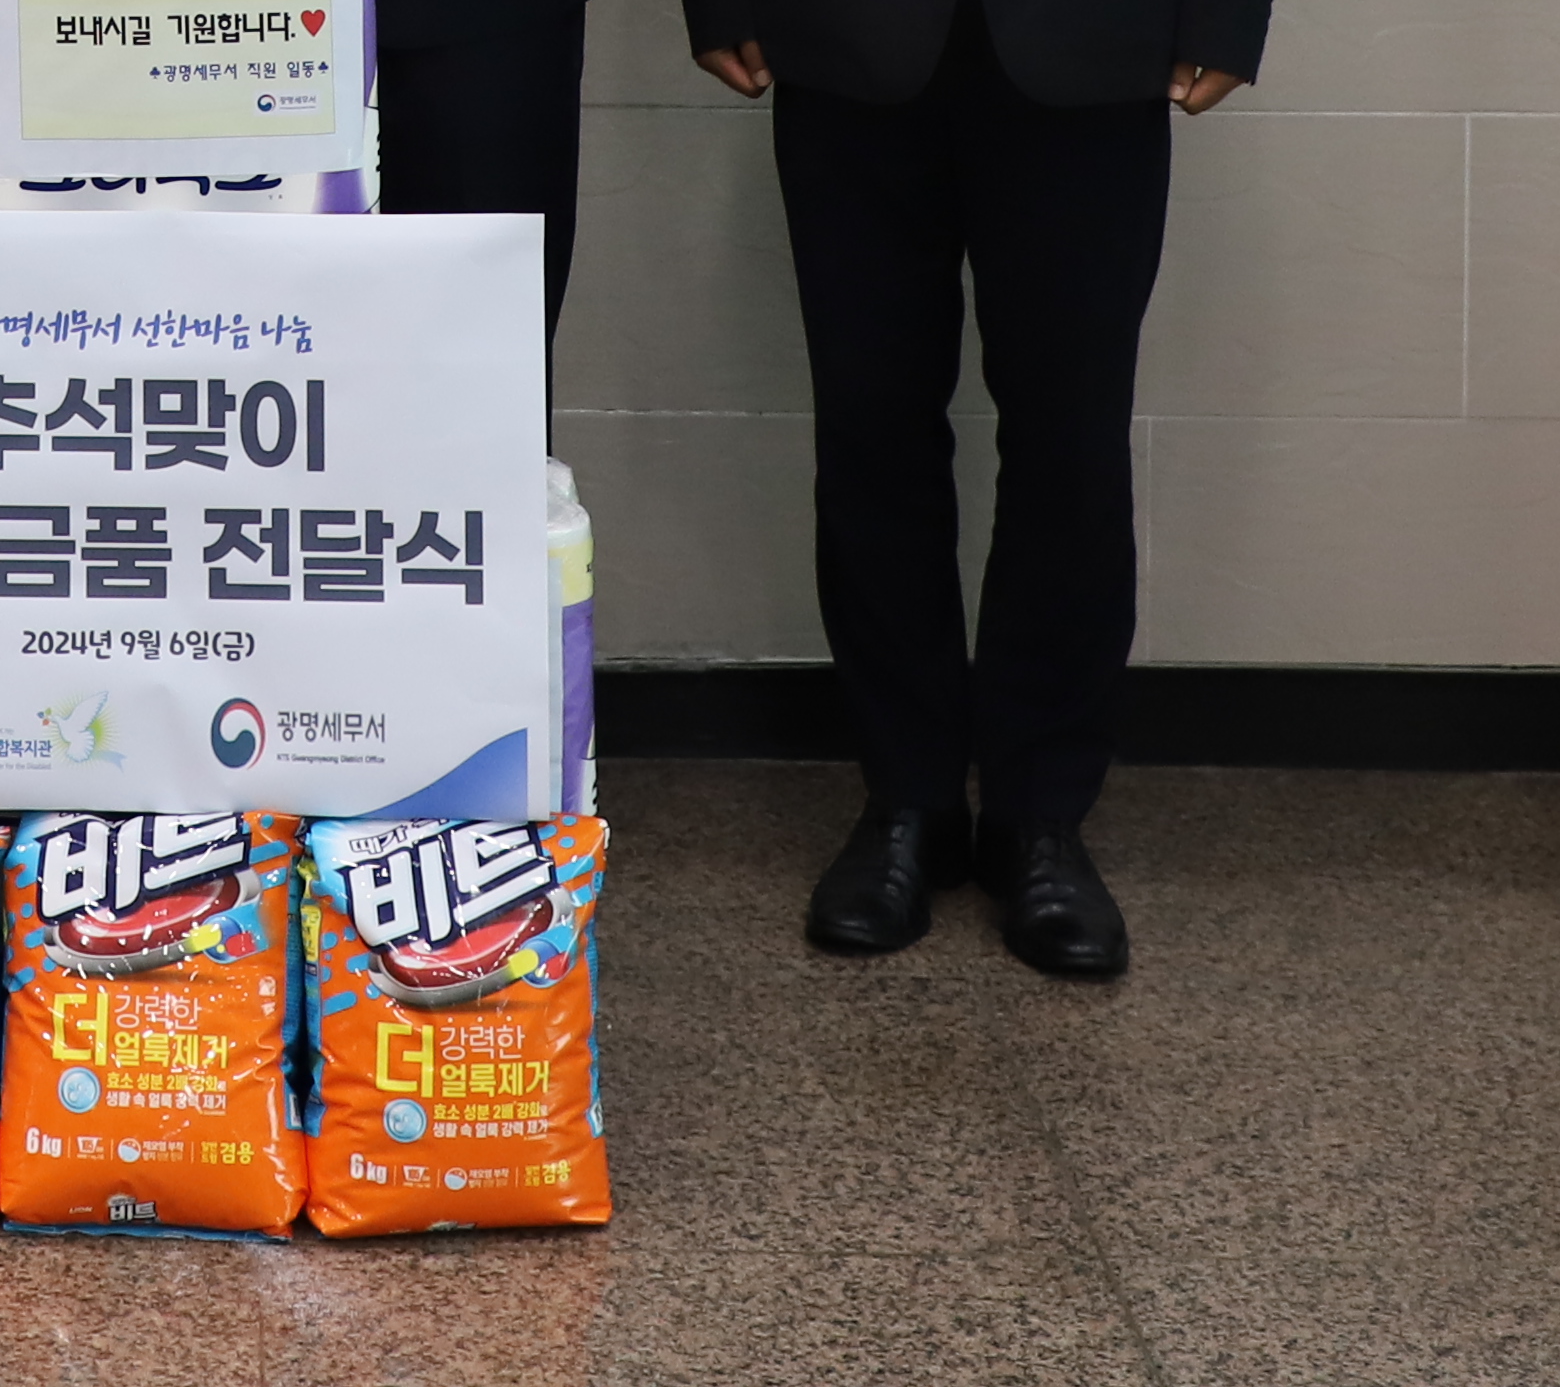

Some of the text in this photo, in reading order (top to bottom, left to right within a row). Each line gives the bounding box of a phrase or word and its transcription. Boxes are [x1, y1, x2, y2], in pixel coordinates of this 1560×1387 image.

[57, 12, 295, 45] 보내시길 기원합니다.
[164, 61, 314, 82] 광명세무서 직원 일동
[133, 310, 249, 349] 선한마음
[261, 314, 312, 353] 나눔
[203, 508, 483, 604] 전달식
[22, 630, 254, 661] 2024년 9월 6일(금)
[278, 712, 384, 742] 광명세무서
[42, 813, 249, 919] 비트
[347, 822, 553, 949] 비트
[52, 993, 109, 1066] 더
[113, 994, 202, 1030] 강력한
[113, 1031, 228, 1069] 얼룩제거
[375, 1022, 434, 1097] 더
[440, 1025, 525, 1061] 강력한
[440, 1061, 550, 1098] 얼룩제거
